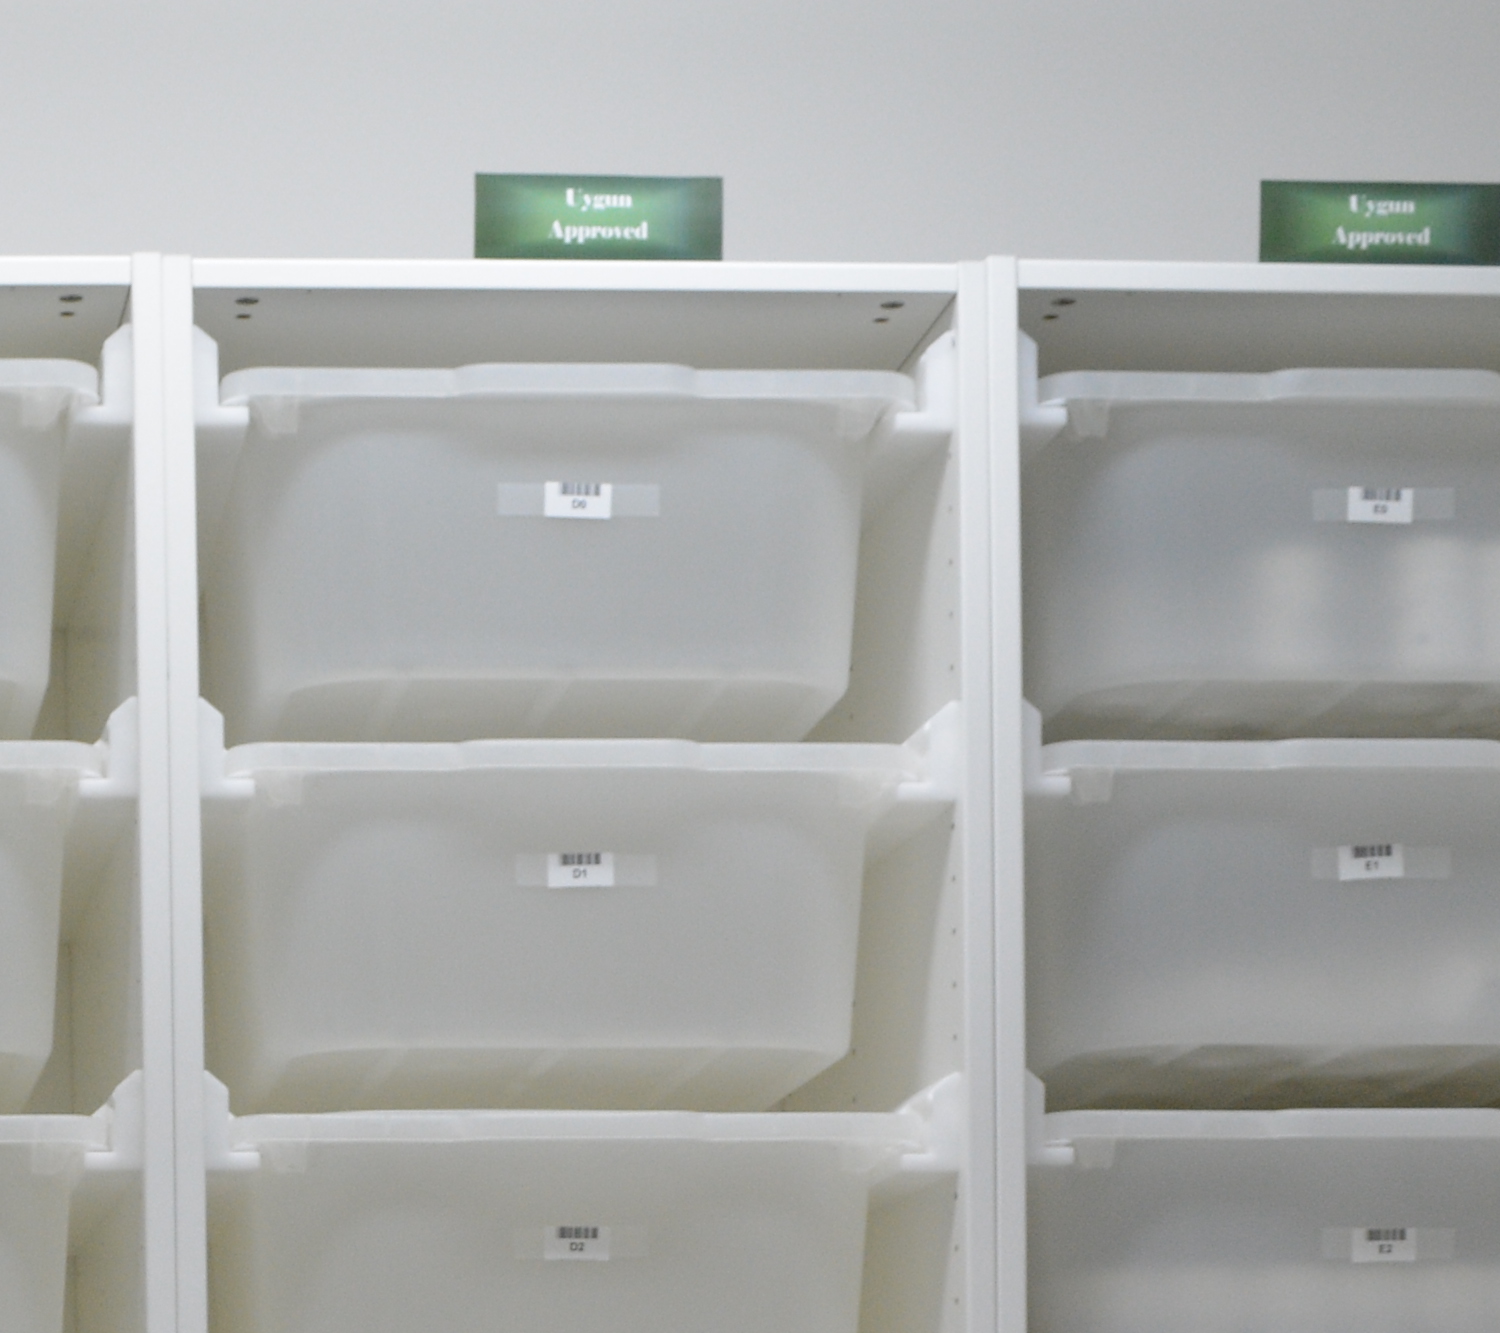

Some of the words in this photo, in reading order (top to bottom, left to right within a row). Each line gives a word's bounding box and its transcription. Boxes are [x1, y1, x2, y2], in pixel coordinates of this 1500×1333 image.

[565, 187, 632, 210] Uygun
[1348, 195, 1415, 217] Uygun
[548, 220, 648, 244] Approved
[1334, 226, 1431, 250] Approved
[571, 498, 588, 510] D0
[1364, 859, 1380, 872] E1
[571, 867, 588, 880] D1
[568, 1241, 586, 1253] D2
[1377, 1243, 1394, 1255] E2
